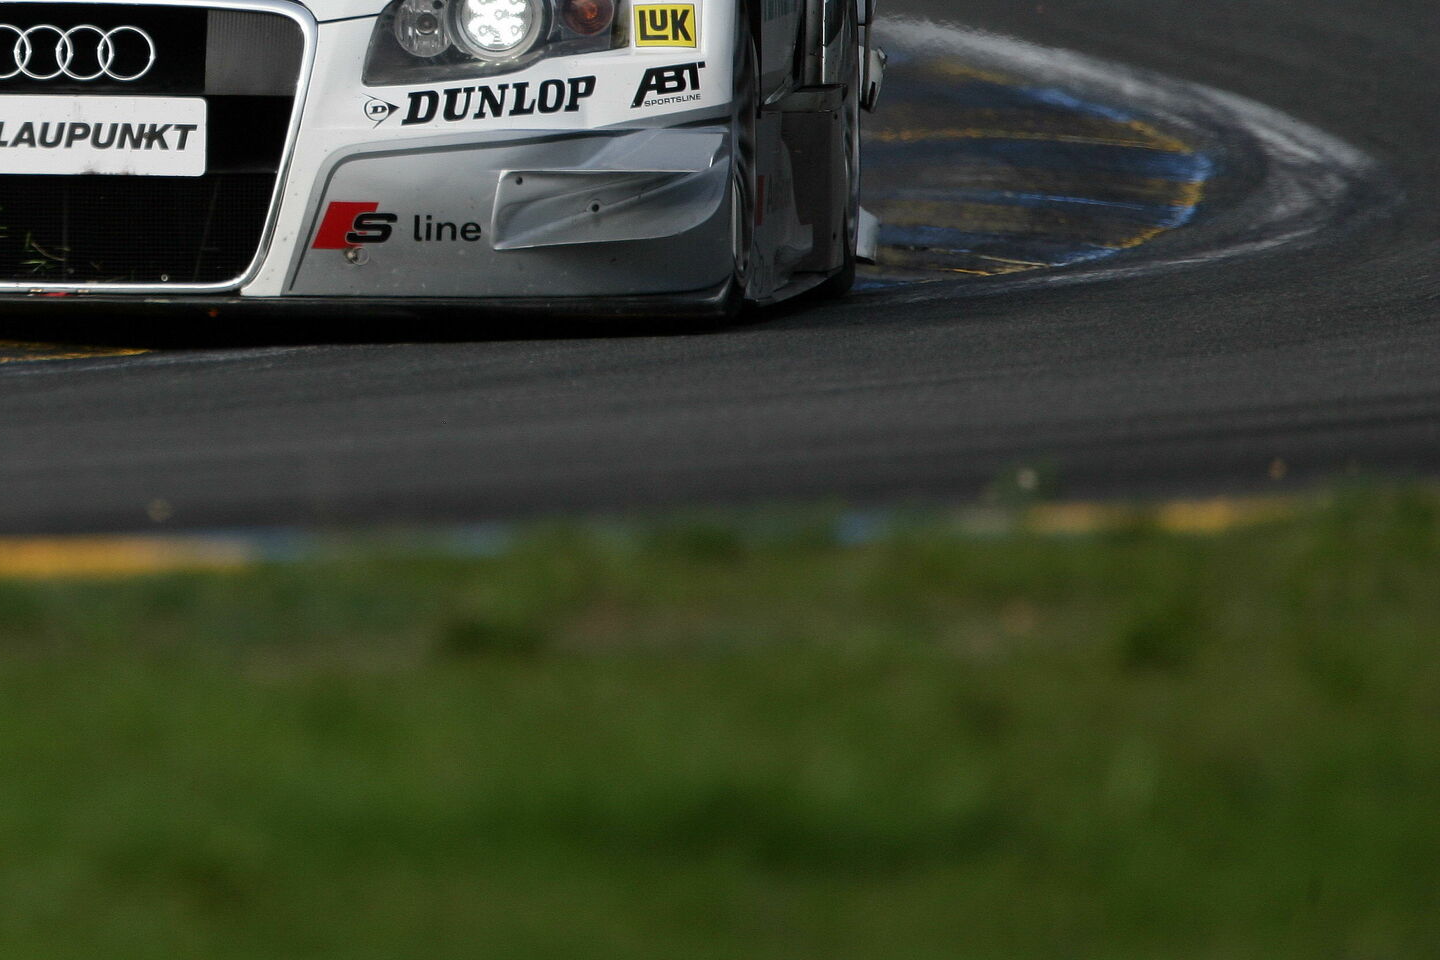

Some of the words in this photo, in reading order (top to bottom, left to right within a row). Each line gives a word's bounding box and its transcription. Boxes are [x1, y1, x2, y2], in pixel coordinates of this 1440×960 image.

[401, 75, 597, 126] DUNLOP
[631, 61, 706, 109] ABT
[644, 92, 702, 108] SPORTSLINE
[346, 212, 398, 244] S
[413, 214, 482, 242] line
